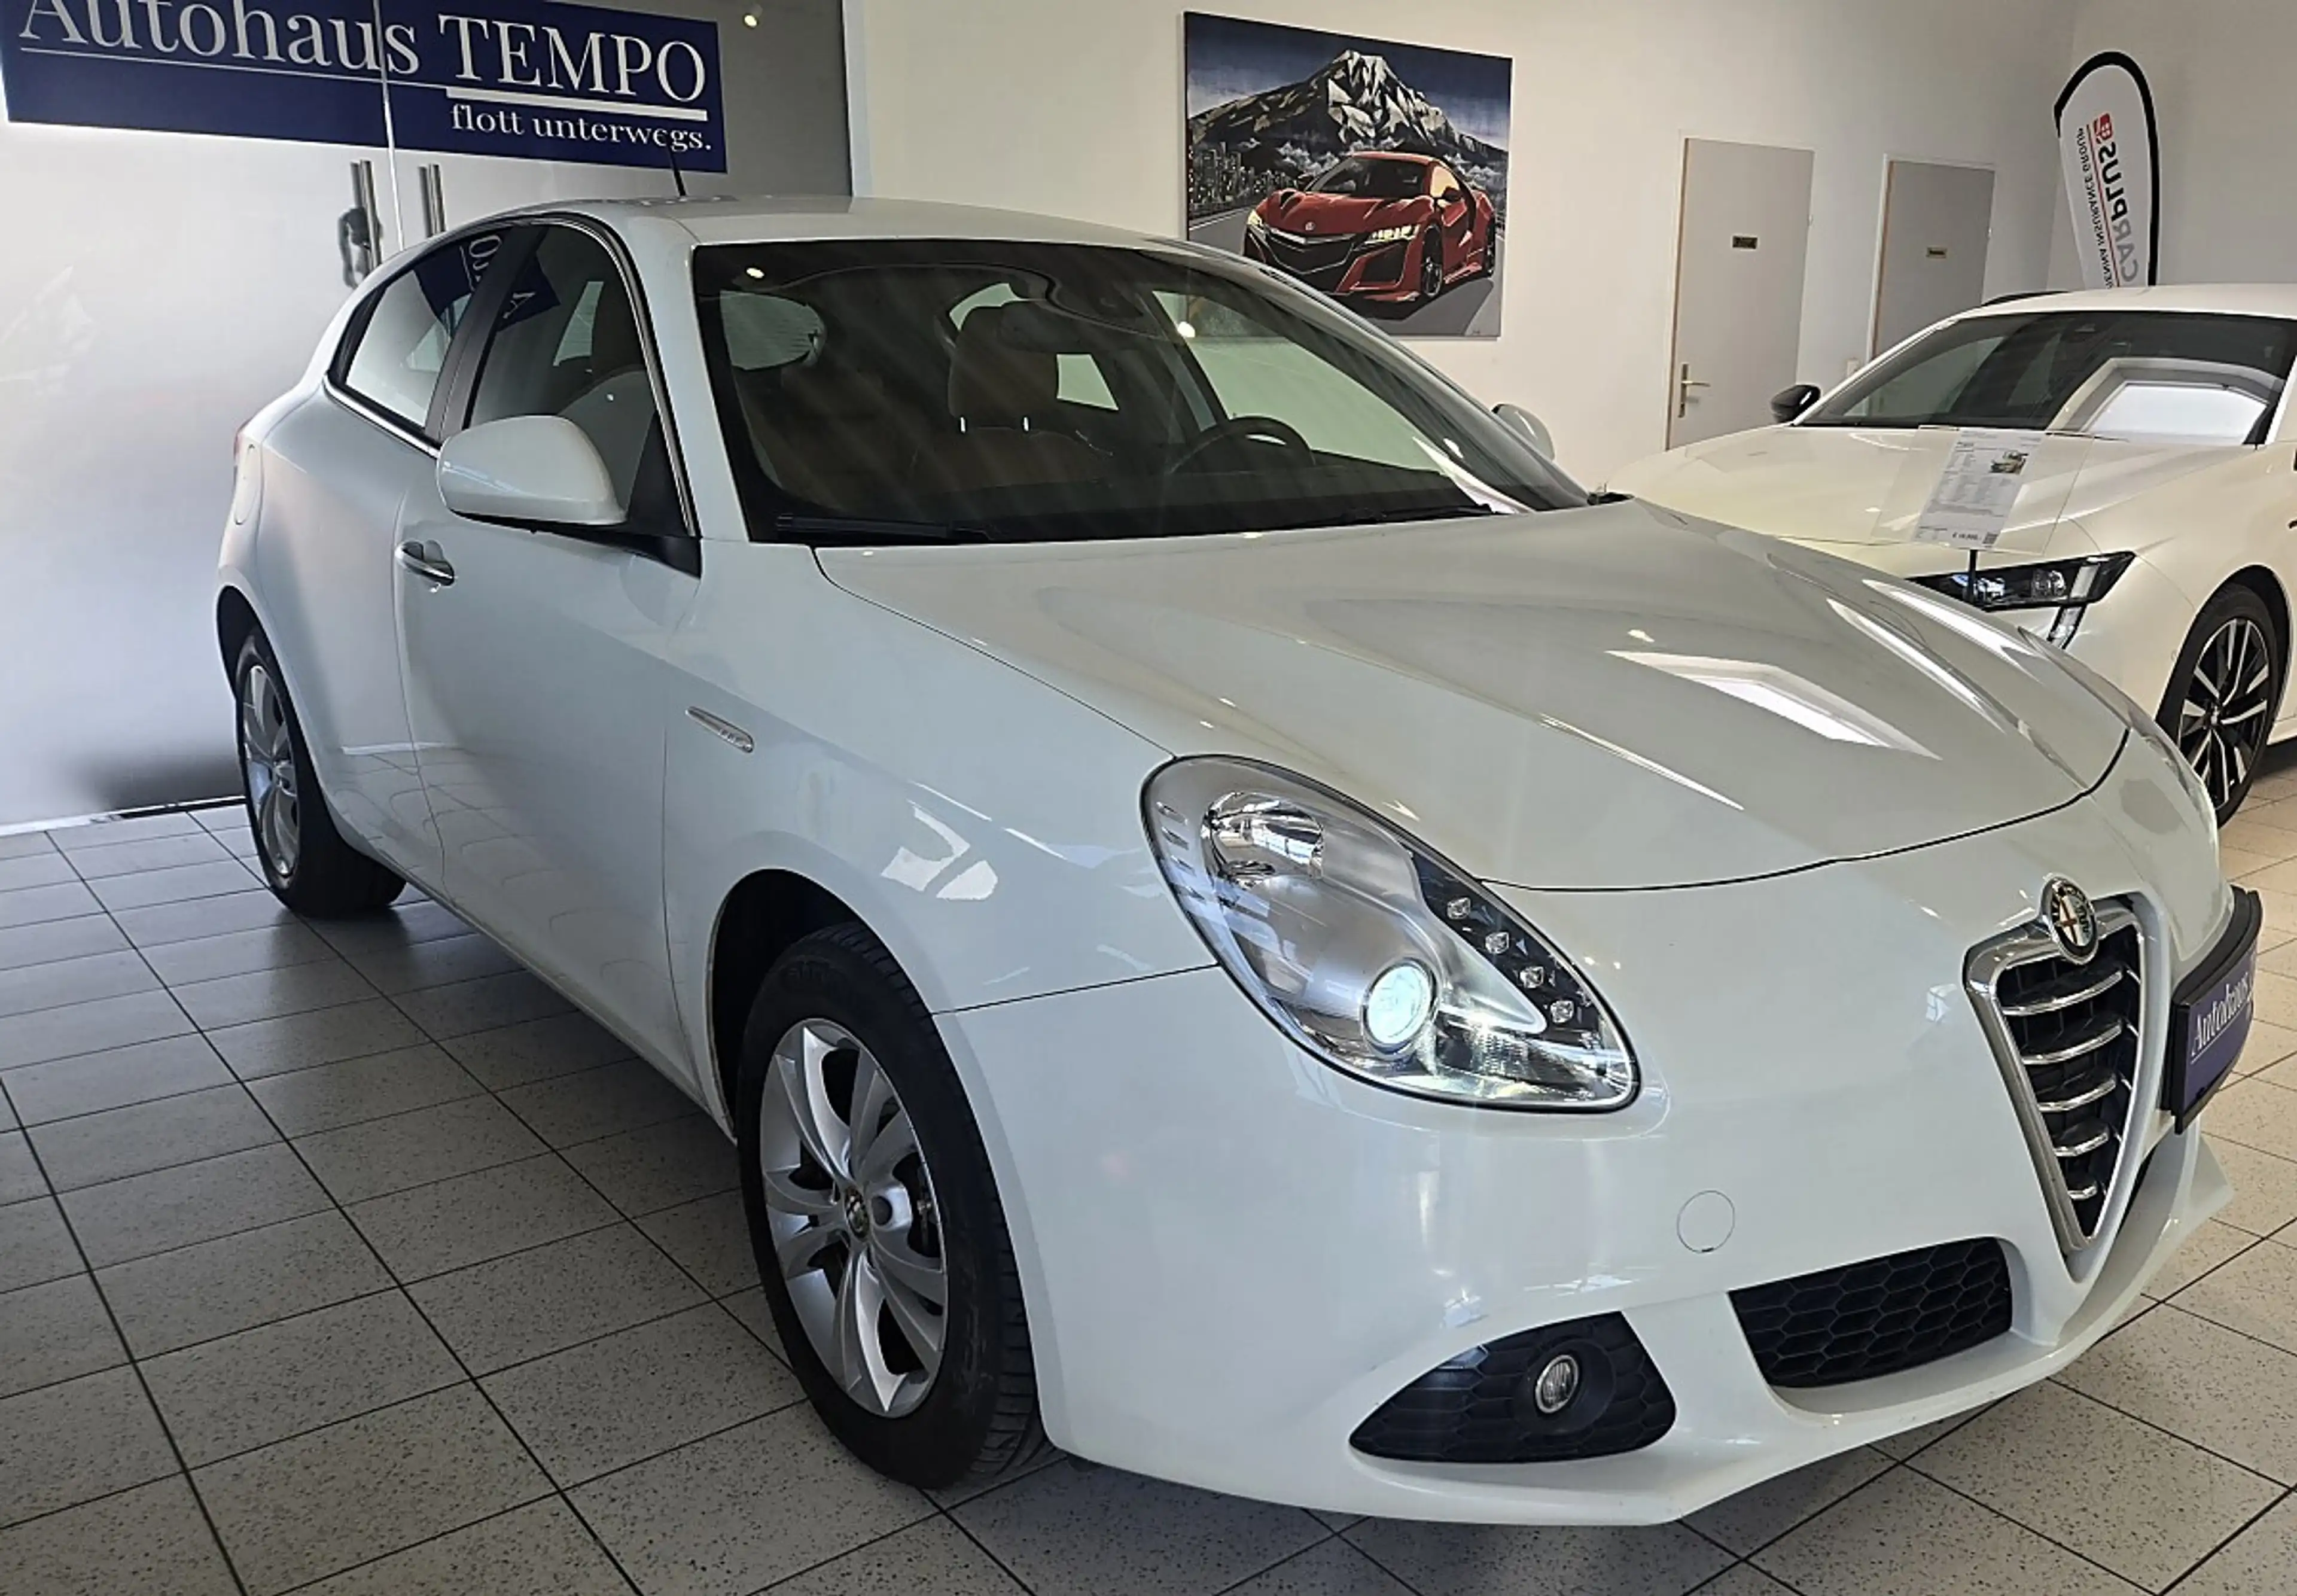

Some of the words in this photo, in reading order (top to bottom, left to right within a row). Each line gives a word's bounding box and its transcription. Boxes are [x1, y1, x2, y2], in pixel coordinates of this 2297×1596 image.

[19, 0, 420, 75] Autohaus
[438, 14, 706, 102] TEMPO
[450, 102, 525, 135] flott
[532, 117, 712, 152] unterwegs.
